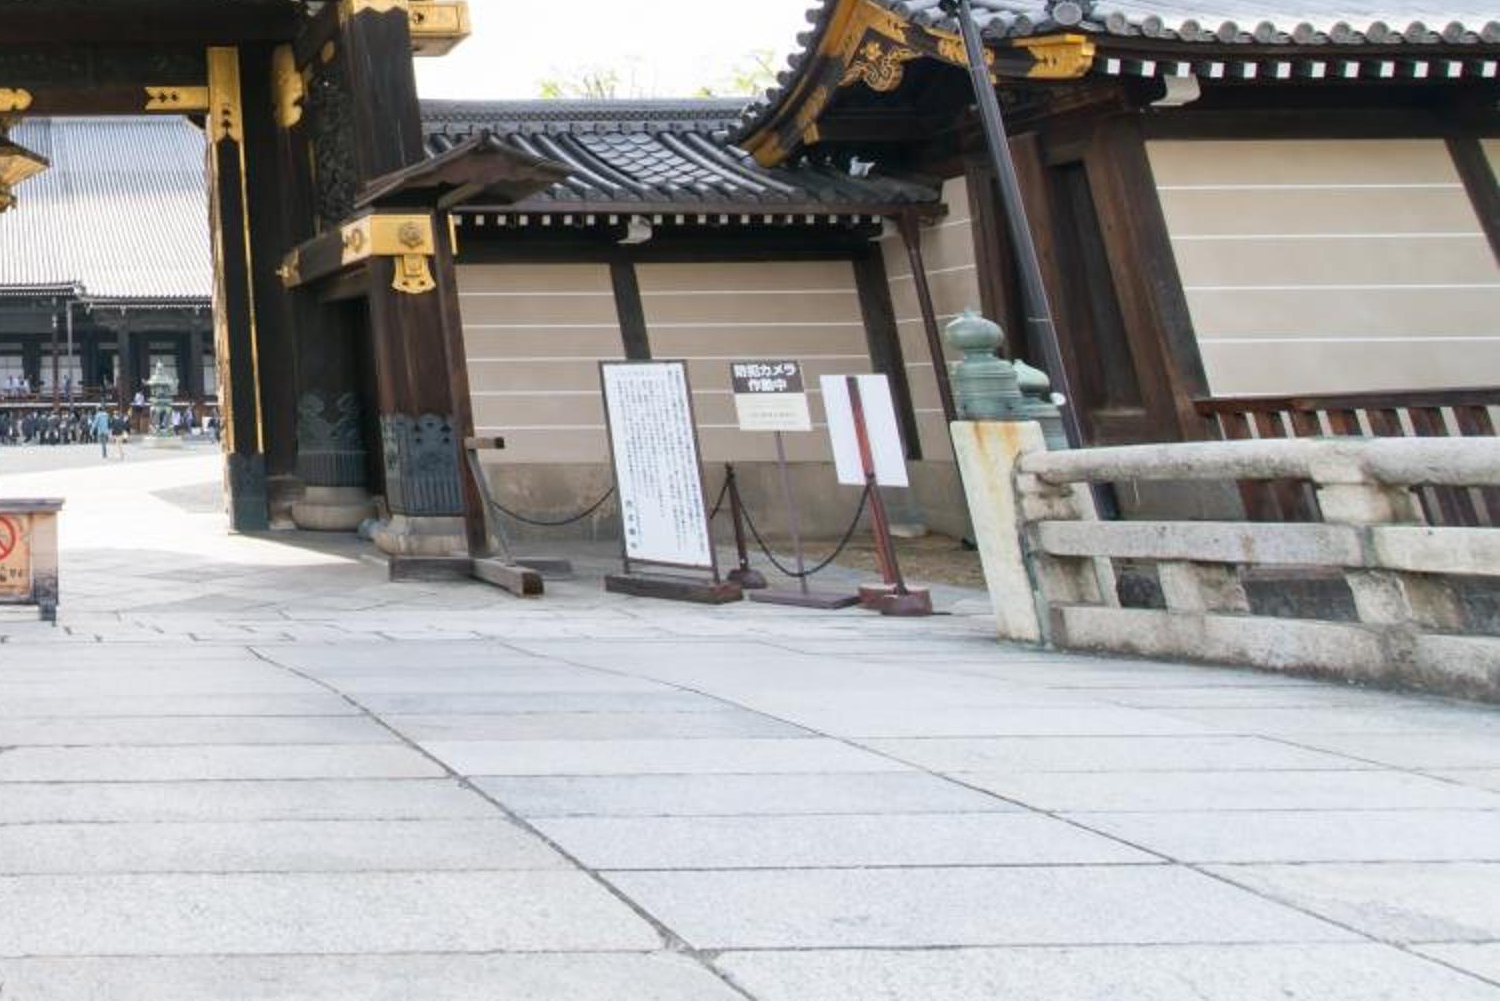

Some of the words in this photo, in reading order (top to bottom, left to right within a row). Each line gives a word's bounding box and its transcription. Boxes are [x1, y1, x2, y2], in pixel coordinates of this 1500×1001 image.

[733, 363, 797, 378] 防犯カメラ
